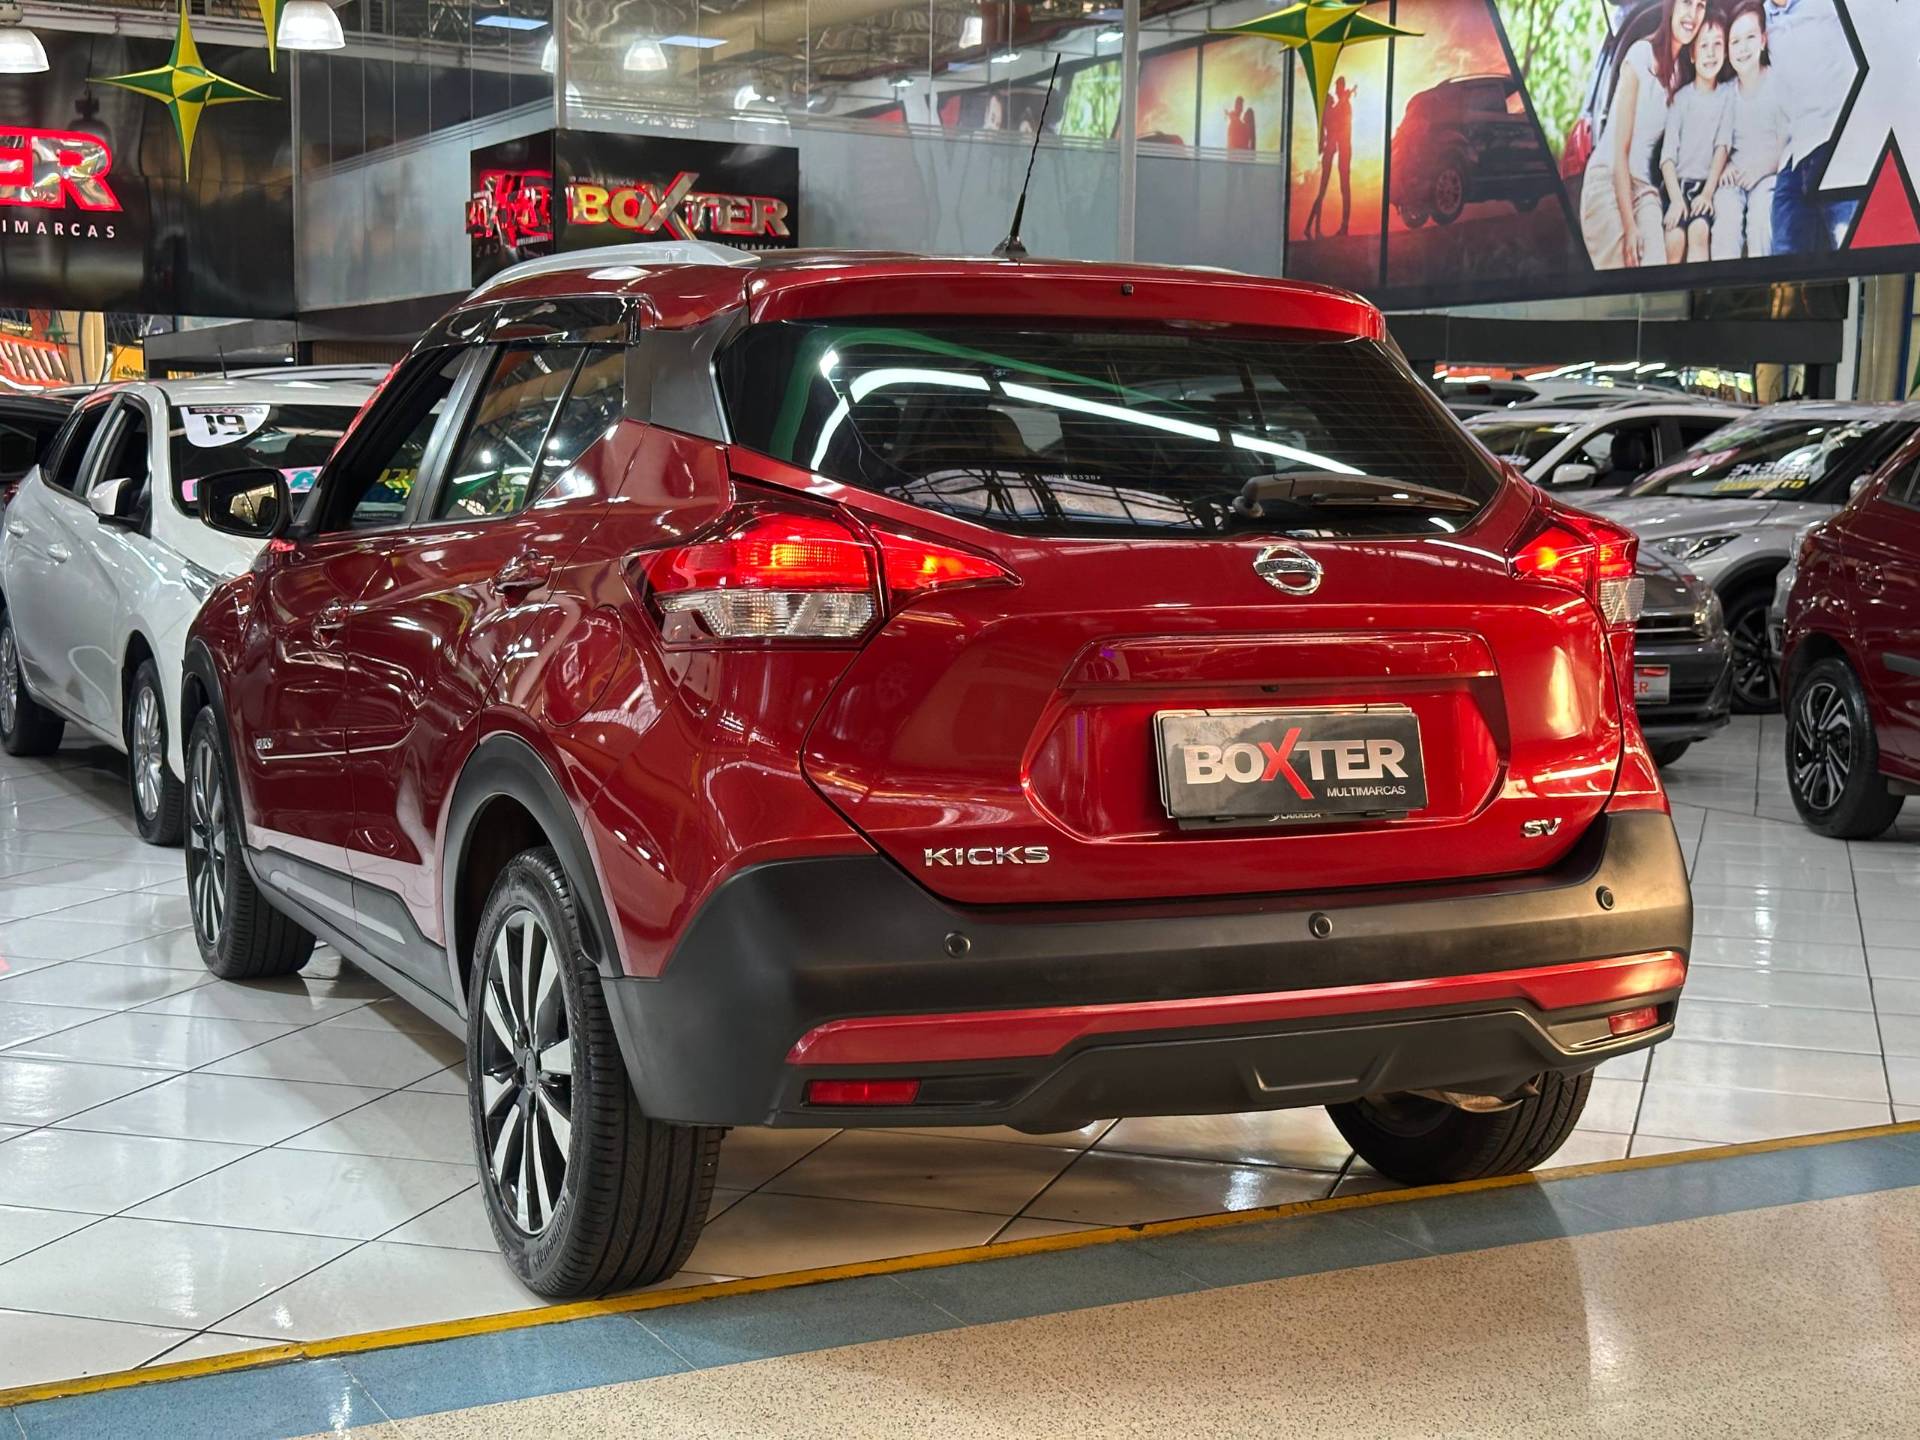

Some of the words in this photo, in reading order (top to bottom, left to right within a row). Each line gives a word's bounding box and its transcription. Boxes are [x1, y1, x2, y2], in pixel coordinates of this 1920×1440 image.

[564, 171, 791, 240] BOXTER
[203, 414, 248, 435] 19
[1184, 728, 1409, 799] BOXTER
[1327, 785, 1406, 797] MULTIMARCAS
[1522, 817, 1562, 838] SV
[924, 846, 1050, 867] KICKS
